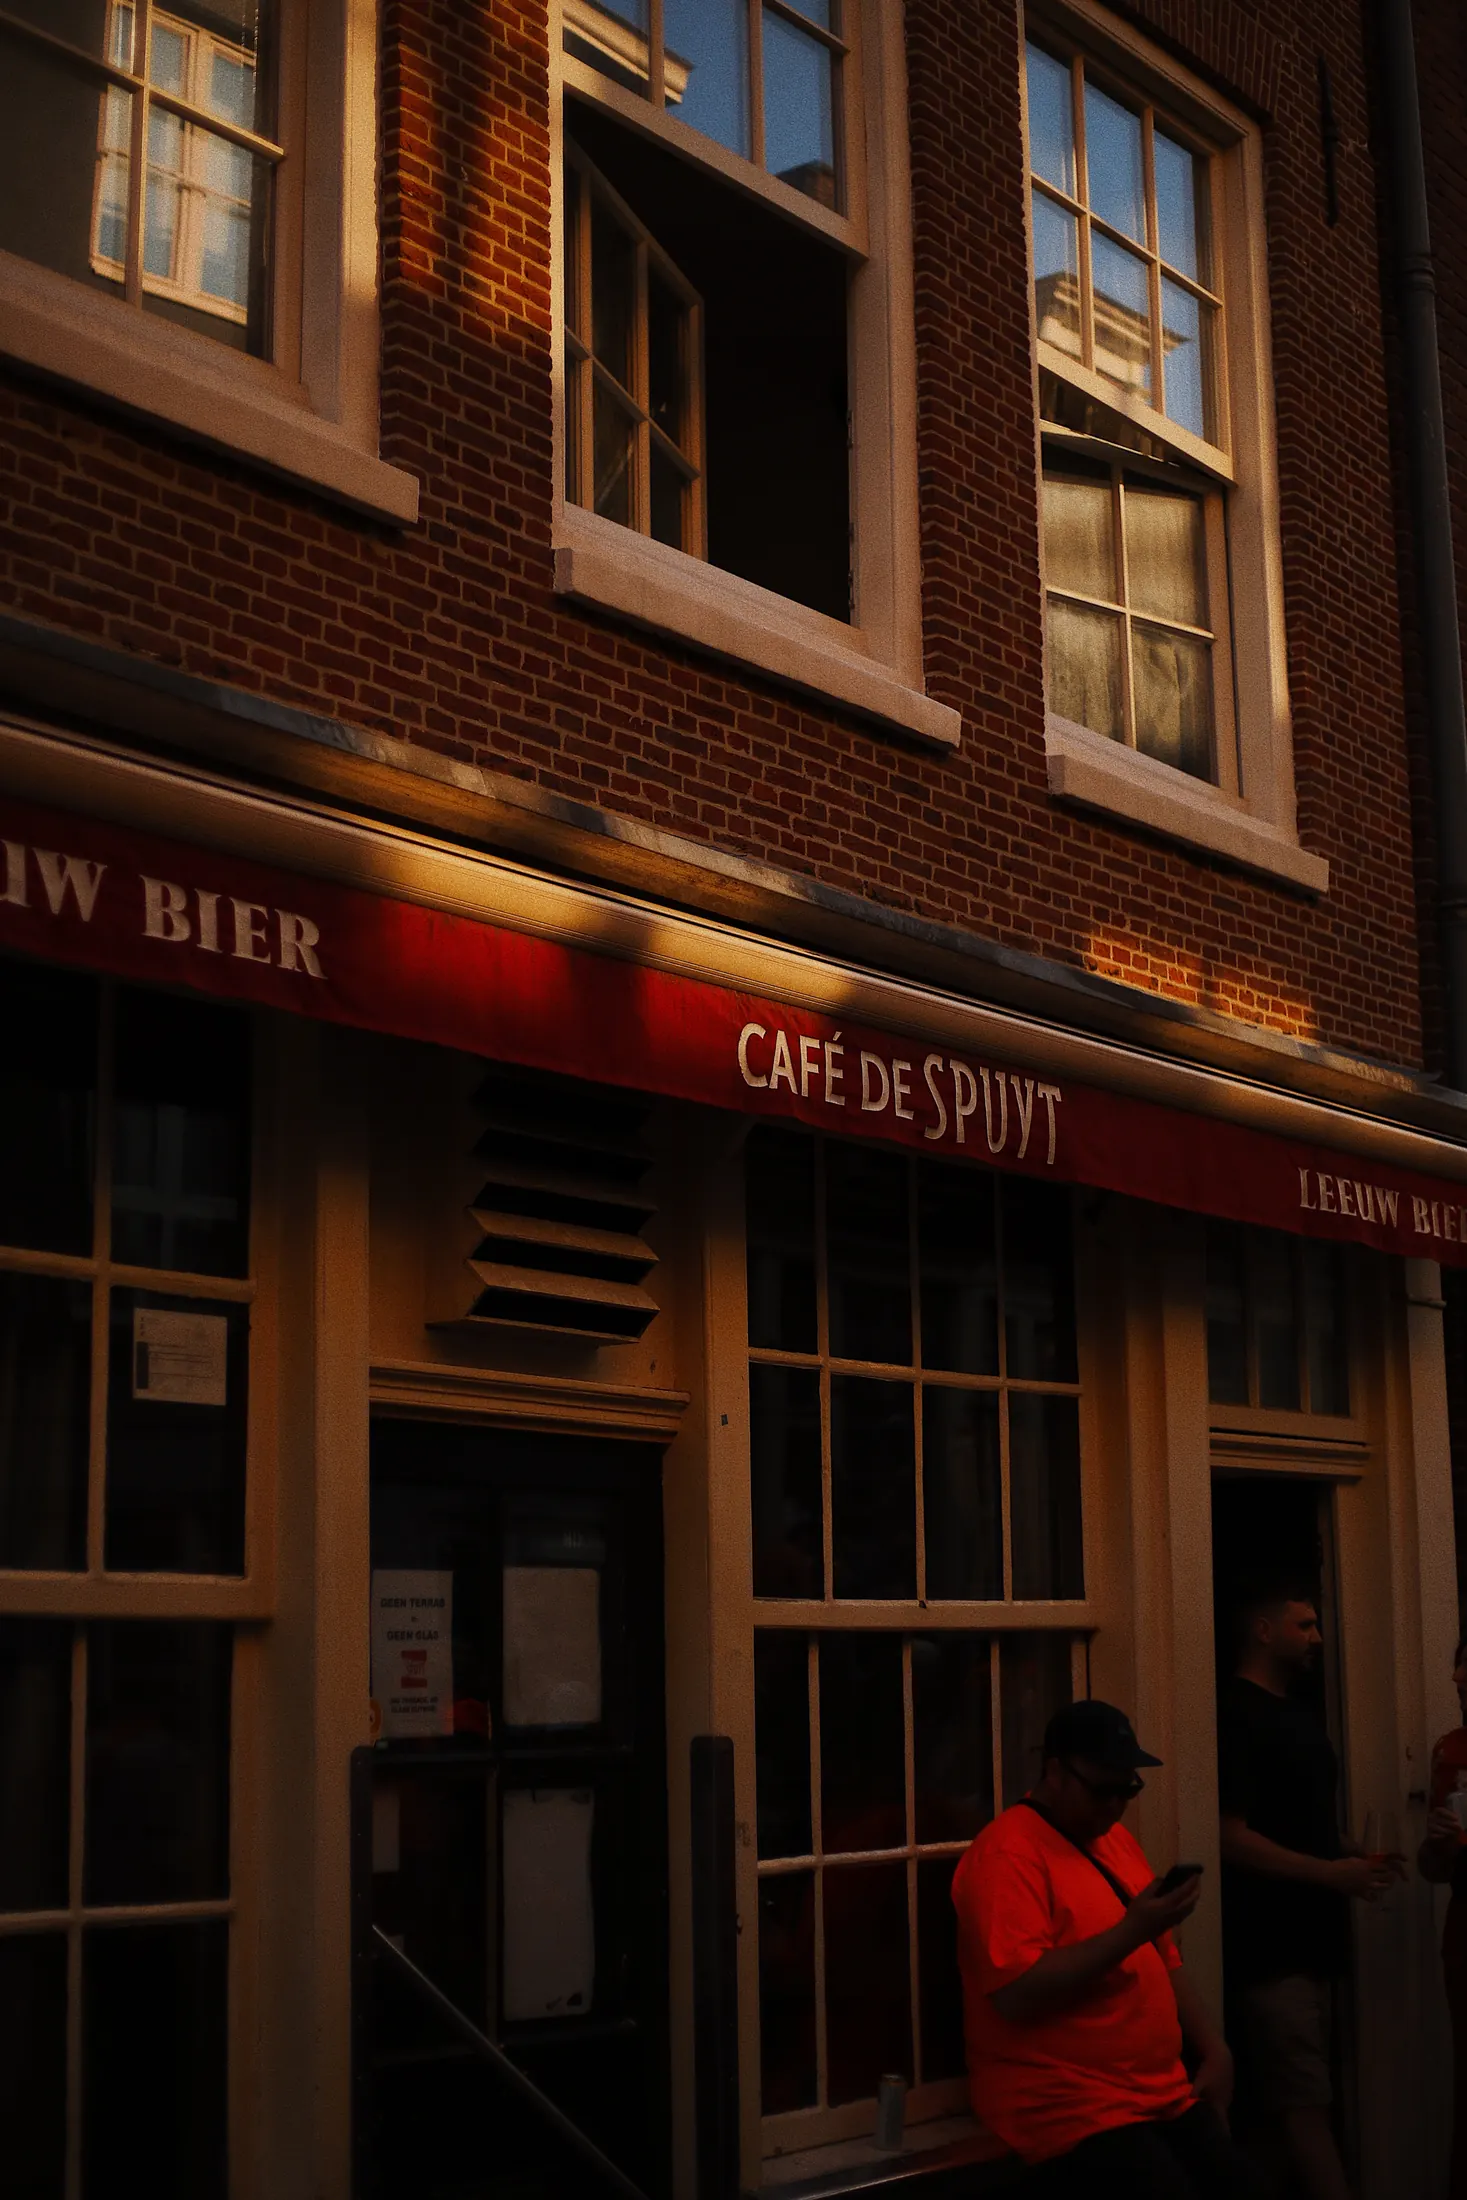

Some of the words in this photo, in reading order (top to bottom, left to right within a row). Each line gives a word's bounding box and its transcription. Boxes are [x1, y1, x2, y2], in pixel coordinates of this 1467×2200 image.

[139, 874, 328, 980] BIER
[737, 1022, 846, 1106] CAFÉ
[860, 1050, 915, 1120] DE
[923, 1053, 1063, 1165] SPUYT
[1298, 1167, 1400, 1228] LEEUW
